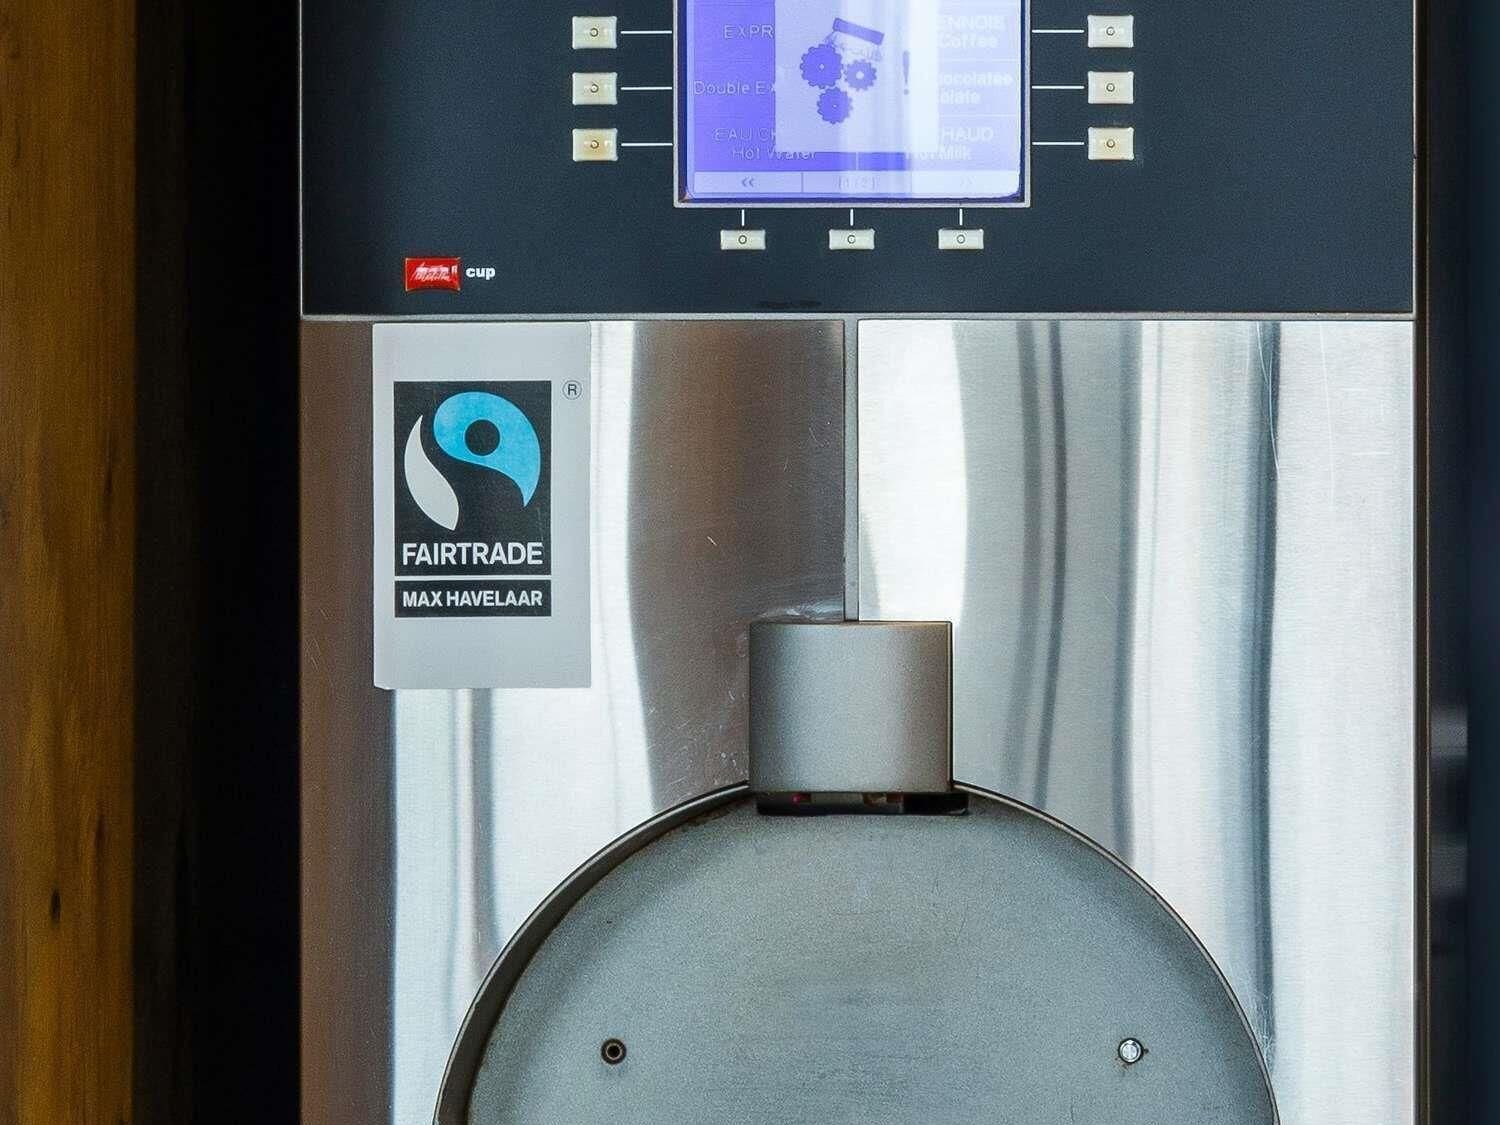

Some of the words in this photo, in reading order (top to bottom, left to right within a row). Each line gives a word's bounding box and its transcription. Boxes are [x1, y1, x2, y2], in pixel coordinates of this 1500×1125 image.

[693, 80, 750, 95] Double
[733, 147, 761, 160] Hot
[465, 266, 496, 281] cup
[402, 542, 544, 566] FAIRTRADE
[402, 591, 443, 608] MAX
[446, 590, 543, 607] HAVELAAR
